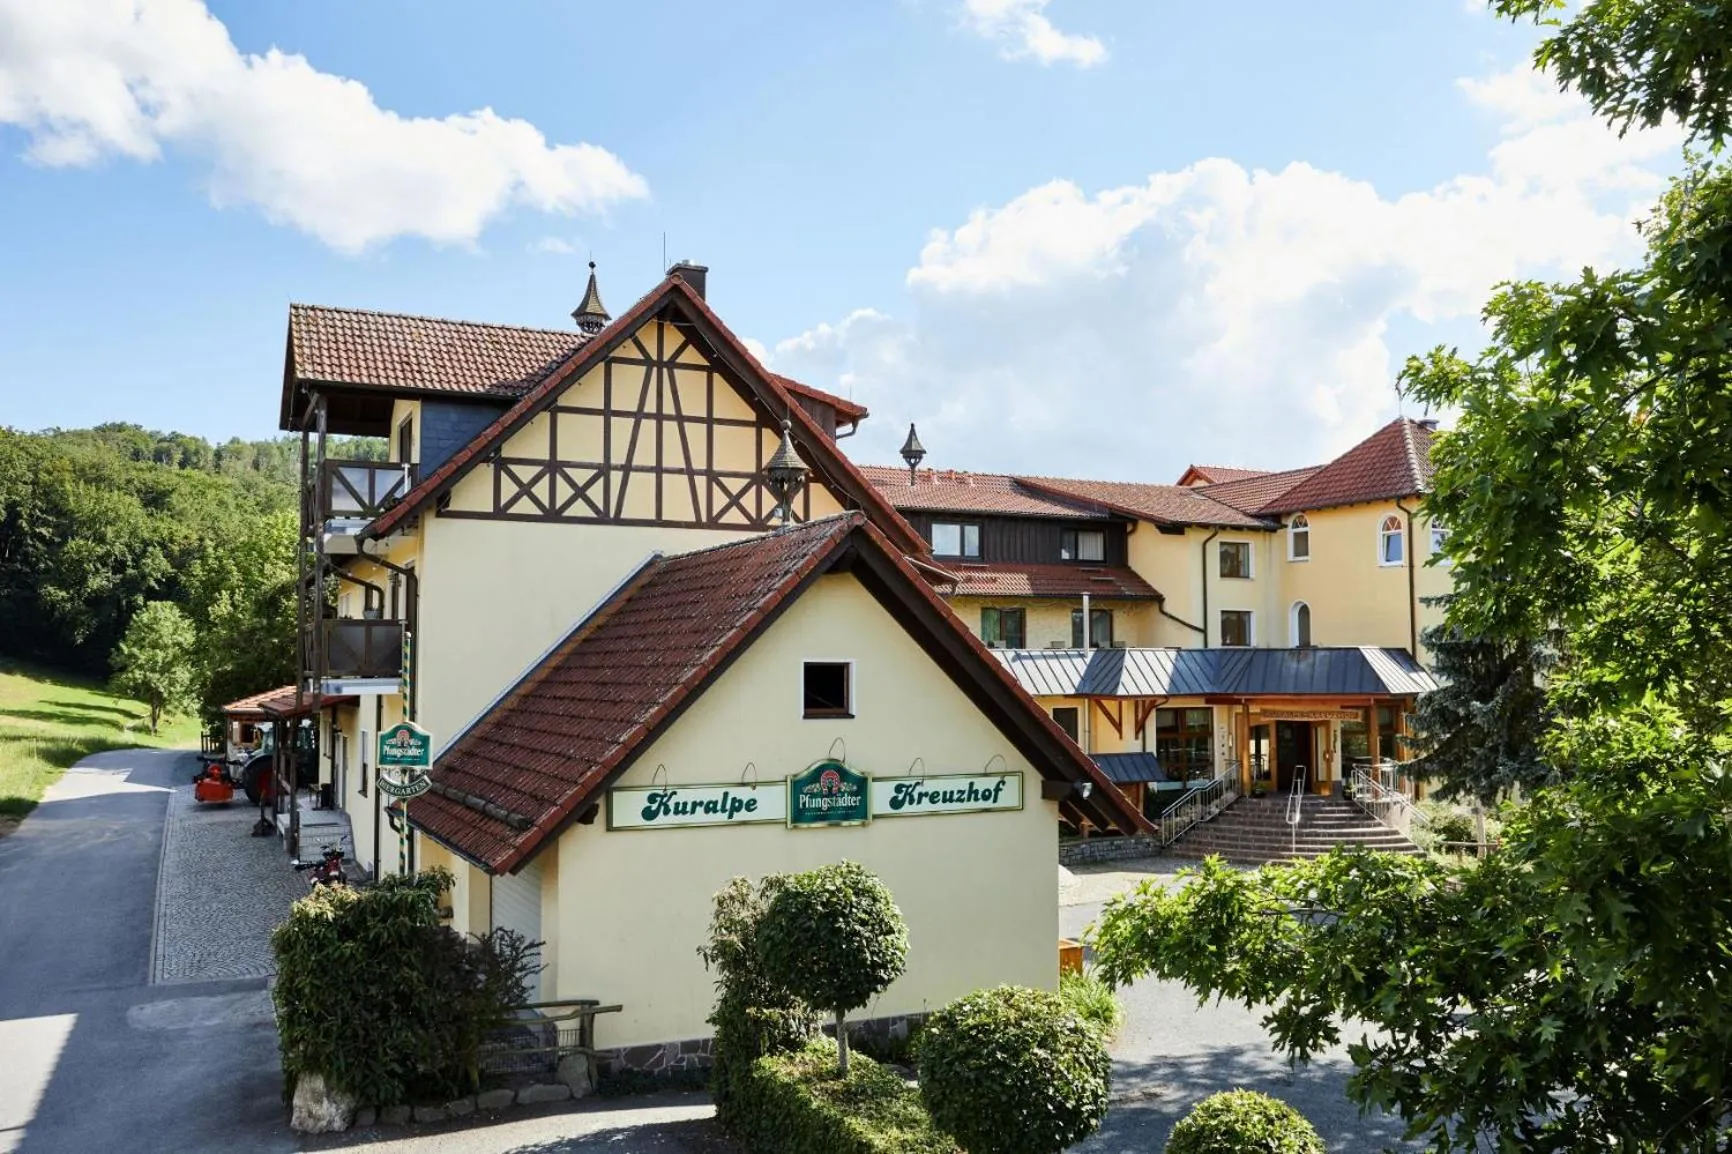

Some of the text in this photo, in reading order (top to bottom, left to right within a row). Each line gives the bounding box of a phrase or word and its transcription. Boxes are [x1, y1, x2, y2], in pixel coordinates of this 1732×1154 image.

[641, 790, 758, 821] Kuralpe
[799, 793, 862, 811] Pfungstädter
[888, 779, 1006, 811] Kreuzhof
